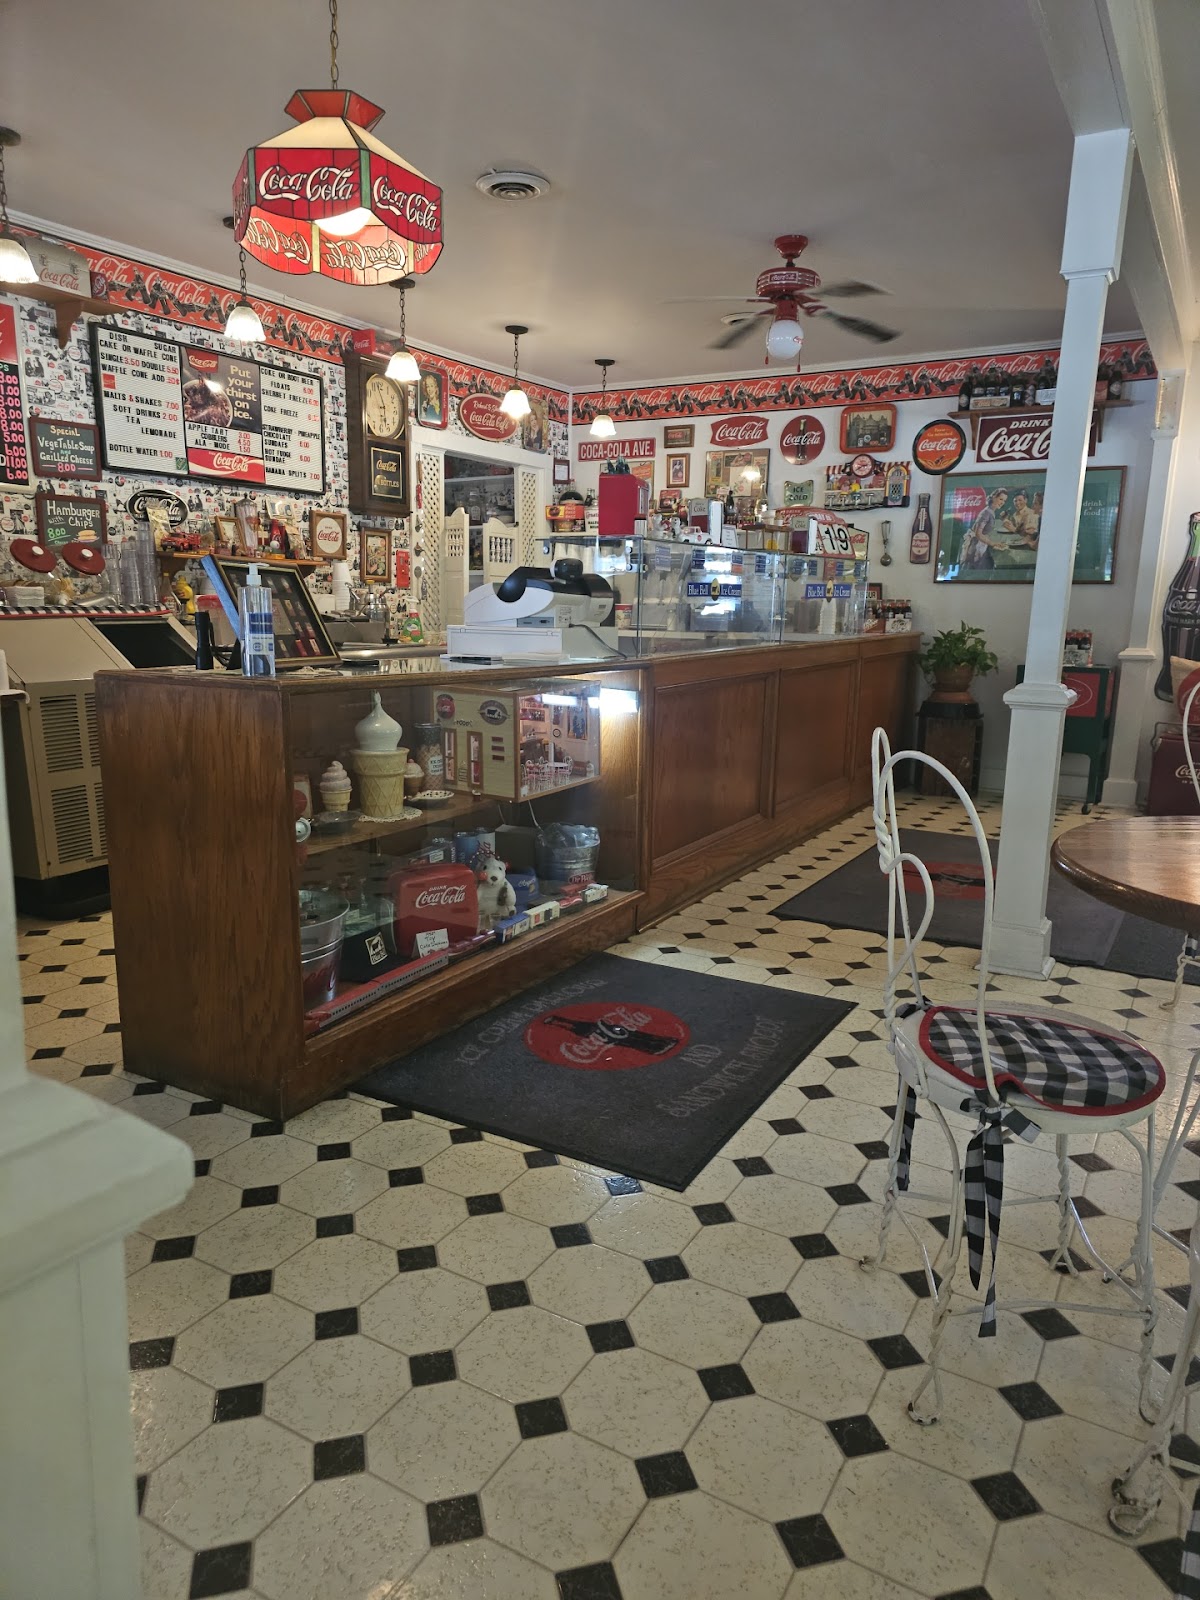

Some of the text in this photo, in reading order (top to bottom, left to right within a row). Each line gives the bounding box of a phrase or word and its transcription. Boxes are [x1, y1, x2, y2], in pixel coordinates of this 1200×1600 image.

[109, 332, 128, 342] DISH
[100, 339, 178, 363] CAKE OR WAFFLE CONE
[154, 342, 177, 353] SUGAR
[100, 352, 124, 363] SINGLE
[141, 360, 166, 372] DOUBLE
[101, 363, 166, 382] WAFFLE CONE ADD
[230, 365, 252, 379] Put
[261, 368, 314, 386] COKE OR ROOT BEER
[227, 377, 255, 389] your
[270, 381, 290, 391] FLOATS
[103, 390, 127, 401] MALTS
[128, 394, 134, 402] &
[135, 395, 162, 407] SHAKES
[225, 387, 257, 402] thirst
[262, 388, 286, 400] SHERBET
[289, 394, 308, 405] FREEZE
[113, 404, 132, 413] SOFT
[135, 408, 161, 419] DRINKS
[234, 400, 250, 410] on
[263, 405, 299, 418] COKE FREEZE
[125, 415, 141, 424] TEA
[233, 407, 253, 420] ice.
[0, 419, 24, 432] 8.00
[188, 423, 208, 433] APPLE
[211, 427, 228, 436] TART
[1010, 419, 1050, 430] DRINK
[3, 432, 25, 443] 5.00
[141, 427, 177, 439] LEMONADE
[200, 432, 228, 443] COBBLERS
[261, 423, 321, 440] STRAWBERRY PINEAPPLE
[263, 430, 291, 441] CHOCOLATE
[4, 443, 26, 457] 6.00
[109, 443, 133, 454] BOTTLE
[135, 447, 158, 457] WATER
[195, 438, 207, 447] ALA
[213, 442, 230, 451] MODE
[264, 438, 288, 449] SUNDAES
[580, 440, 654, 459] COCA-COLA AVE.
[264, 448, 275, 456] HOT
[264, 454, 285, 464] SUNDAE
[6, 467, 28, 480] 6.00
[265, 466, 286, 476] BANANA
[288, 469, 307, 478] SPLITS
[380, 478, 400, 488] BOTTLES
[793, 486, 805, 494] ICE
[788, 493, 808, 502] COLD
[68, 516, 94, 529] Chips
[825, 527, 849, 551] 19
[688, 584, 742, 596] Blue Bell Ice Cream
[807, 585, 817, 597] Blue
[816, 585, 825, 597] Bell
[839, 585, 851, 597] Cream
